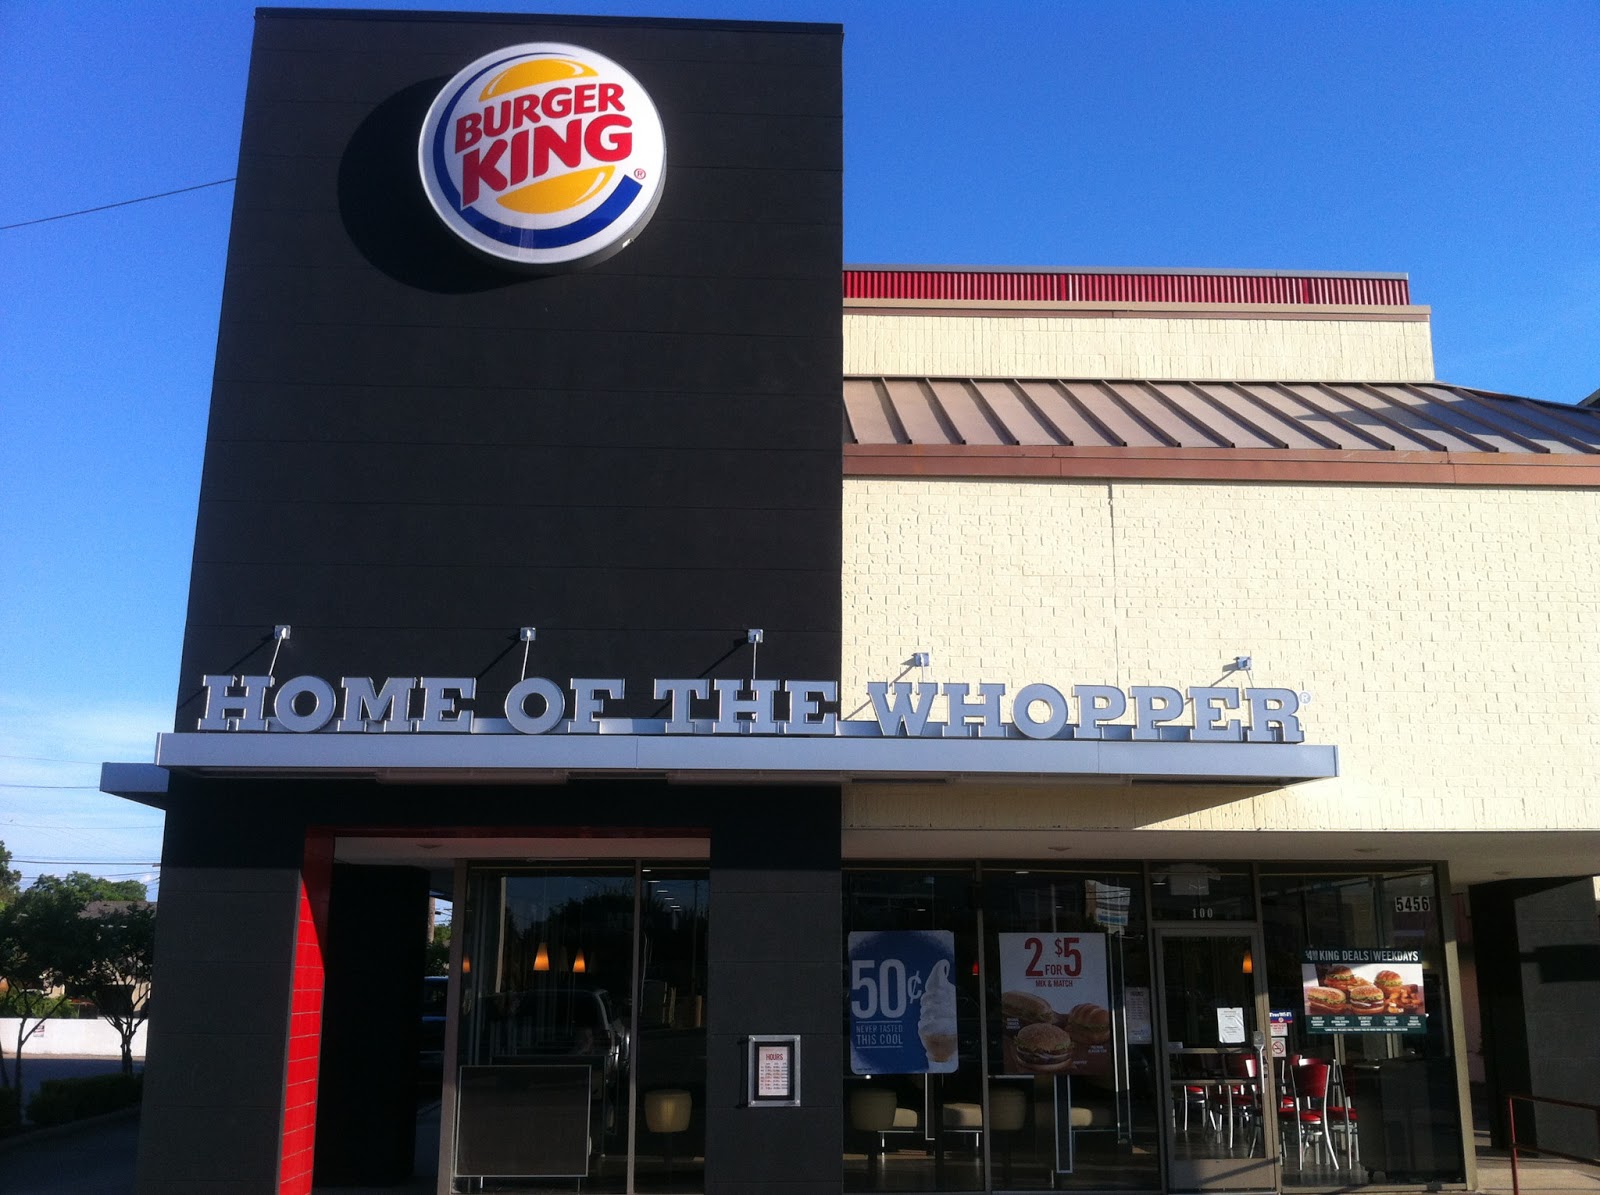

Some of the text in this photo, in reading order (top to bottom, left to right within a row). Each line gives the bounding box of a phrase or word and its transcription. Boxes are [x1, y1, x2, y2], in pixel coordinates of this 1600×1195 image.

[455, 83, 625, 154] BURGER
[462, 113, 632, 207] KING
[197, 673, 1305, 744] HOME OF THE WHOPPER
[1395, 896, 1430, 912] 5456
[1192, 907, 1213, 919] 100
[1024, 936, 1082, 977] 2 FOR $5
[1319, 950, 1340, 961] KING
[1342, 950, 1369, 961] DEALS
[1372, 950, 1419, 961] WEEKDAYS
[851, 958, 922, 1019] 50¢
[1035, 979, 1074, 988] MIX & MATCH
[856, 1024, 903, 1034] NEVER TASTED
[856, 1033, 904, 1045] THIS COOL
[765, 1053, 784, 1061] HOURS
